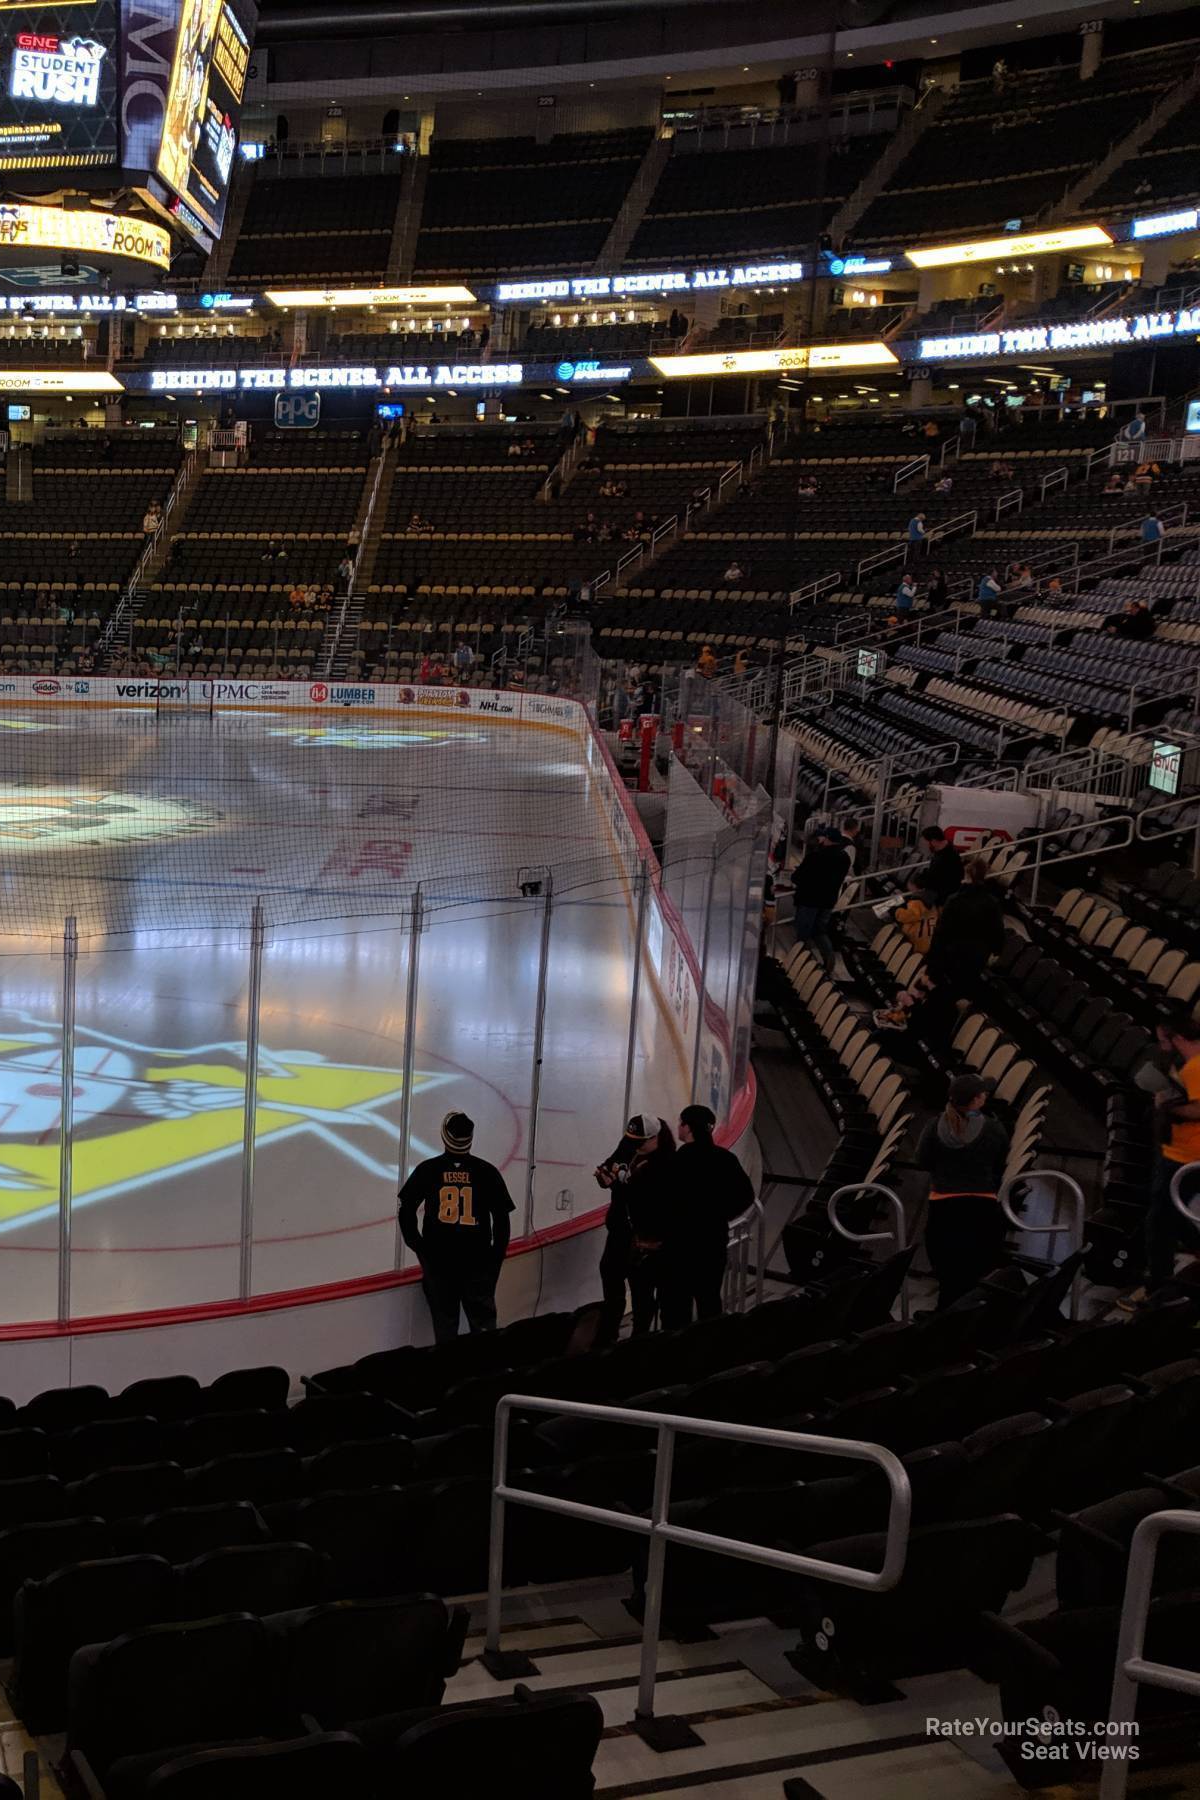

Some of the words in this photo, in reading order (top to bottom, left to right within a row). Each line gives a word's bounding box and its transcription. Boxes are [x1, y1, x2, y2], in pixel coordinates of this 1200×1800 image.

[1079, 20, 1104, 34] 231
[18, 35, 58, 48] GNC
[21, 55, 97, 74] STUDENT
[793, 69, 816, 81] 230
[12, 70, 99, 105] RUSH
[0, 231, 17, 242] TV
[113, 232, 153, 257] ROOM
[692, 270, 729, 289] ALL
[733, 263, 802, 284] ACCESS
[80, 295, 114, 310] ALL
[151, 369, 236, 389] BEHIND
[241, 368, 286, 388] THE
[385, 366, 431, 386] ALL
[435, 363, 523, 385] ACCESS
[907, 367, 930, 380] 120
[277, 395, 319, 424] PPG
[1117, 449, 1135, 462] 121
[32, 683, 62, 694] Glidden
[116, 681, 181, 698] verizon
[202, 684, 259, 700] UPMC
[330, 687, 375, 700] LUMBER
[442, 1171, 471, 1184] KESSEL
[437, 1185, 477, 1227] 81
